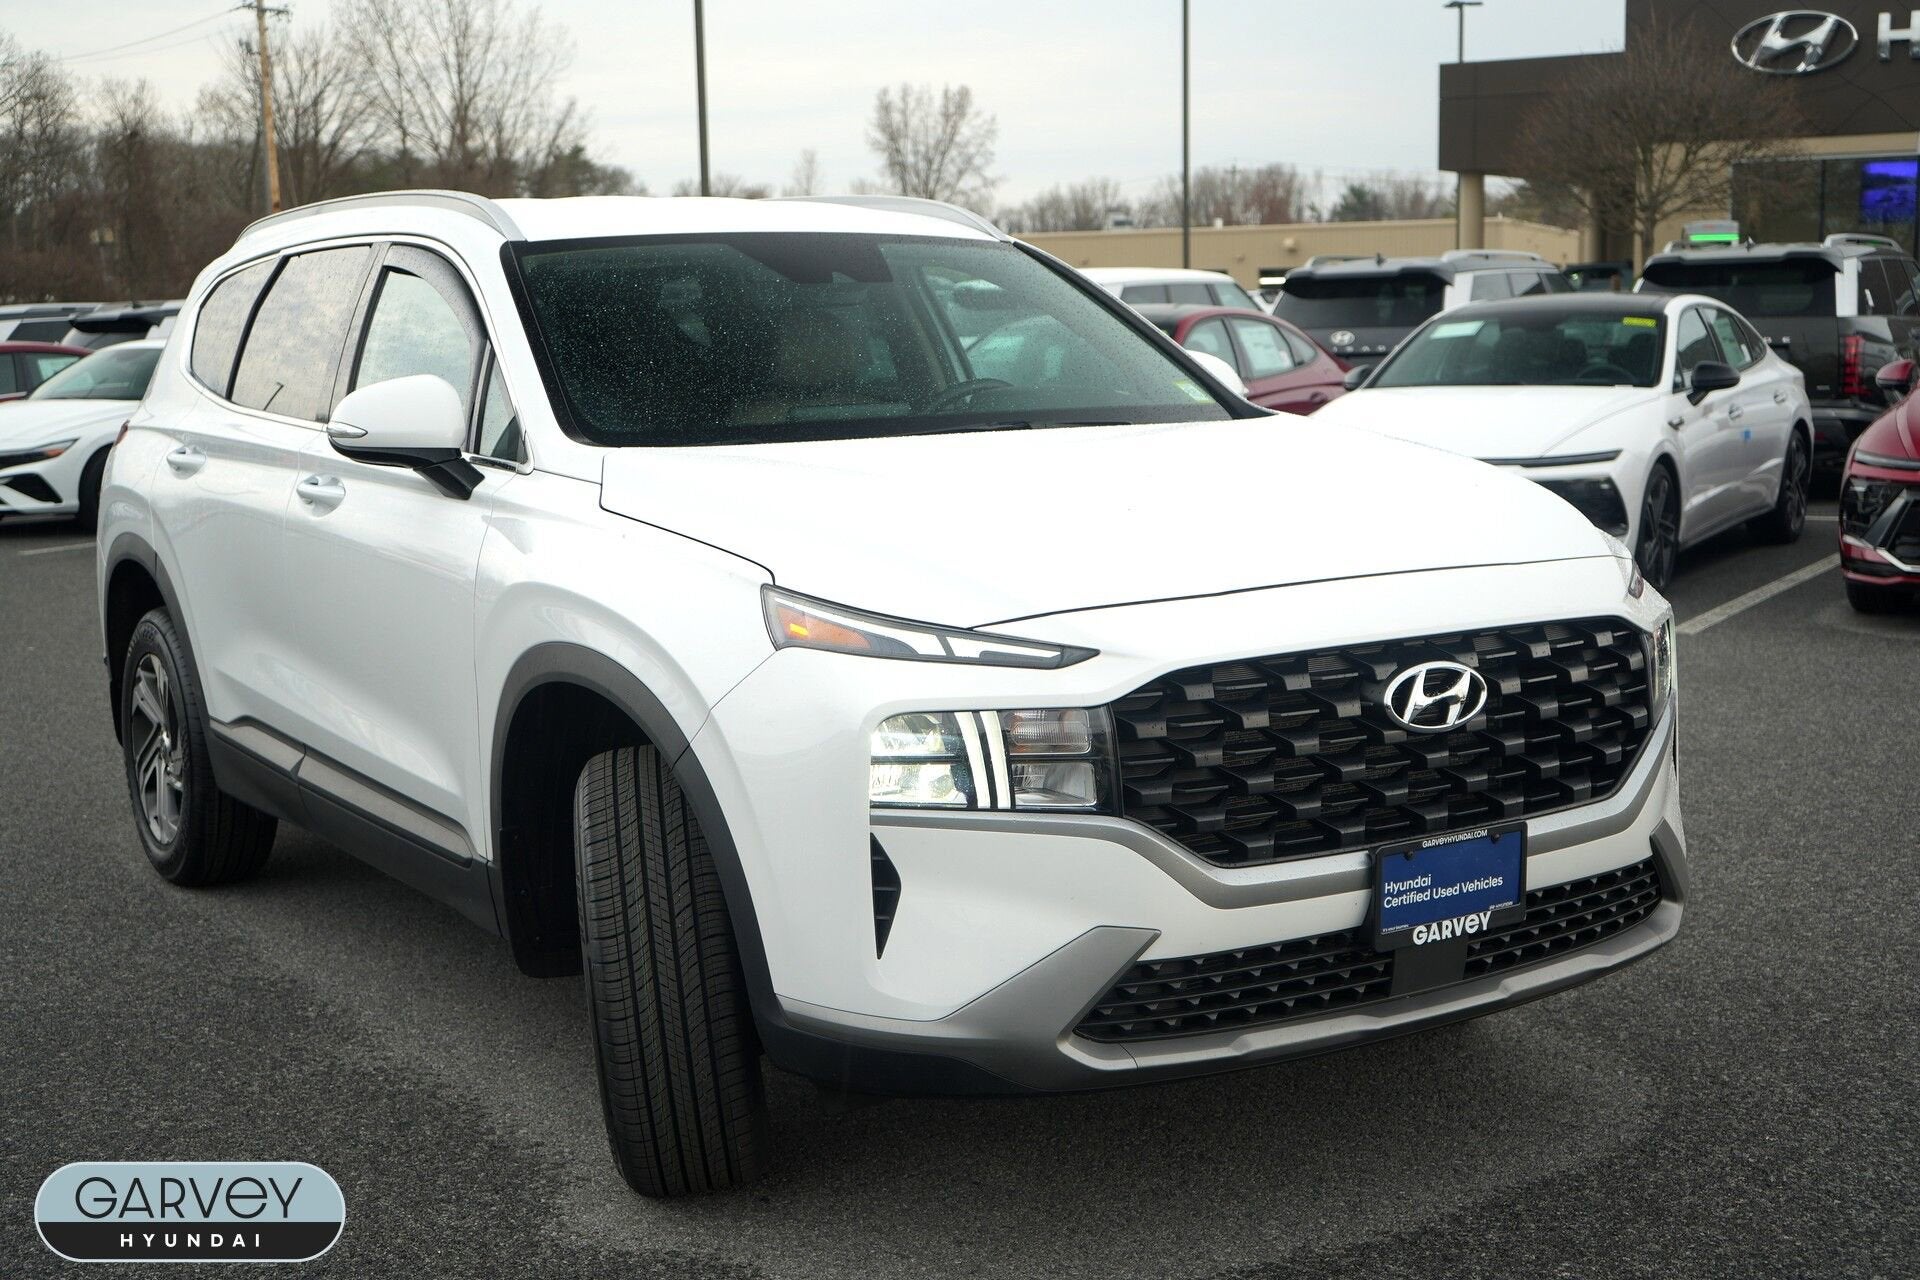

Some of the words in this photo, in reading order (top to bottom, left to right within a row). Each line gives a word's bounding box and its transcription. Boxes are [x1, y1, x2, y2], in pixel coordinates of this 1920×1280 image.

[1383, 889, 1431, 909] Certified
[1432, 884, 1460, 899] Used
[1461, 876, 1504, 894] Vehicles
[1384, 874, 1432, 895] Hyundai
